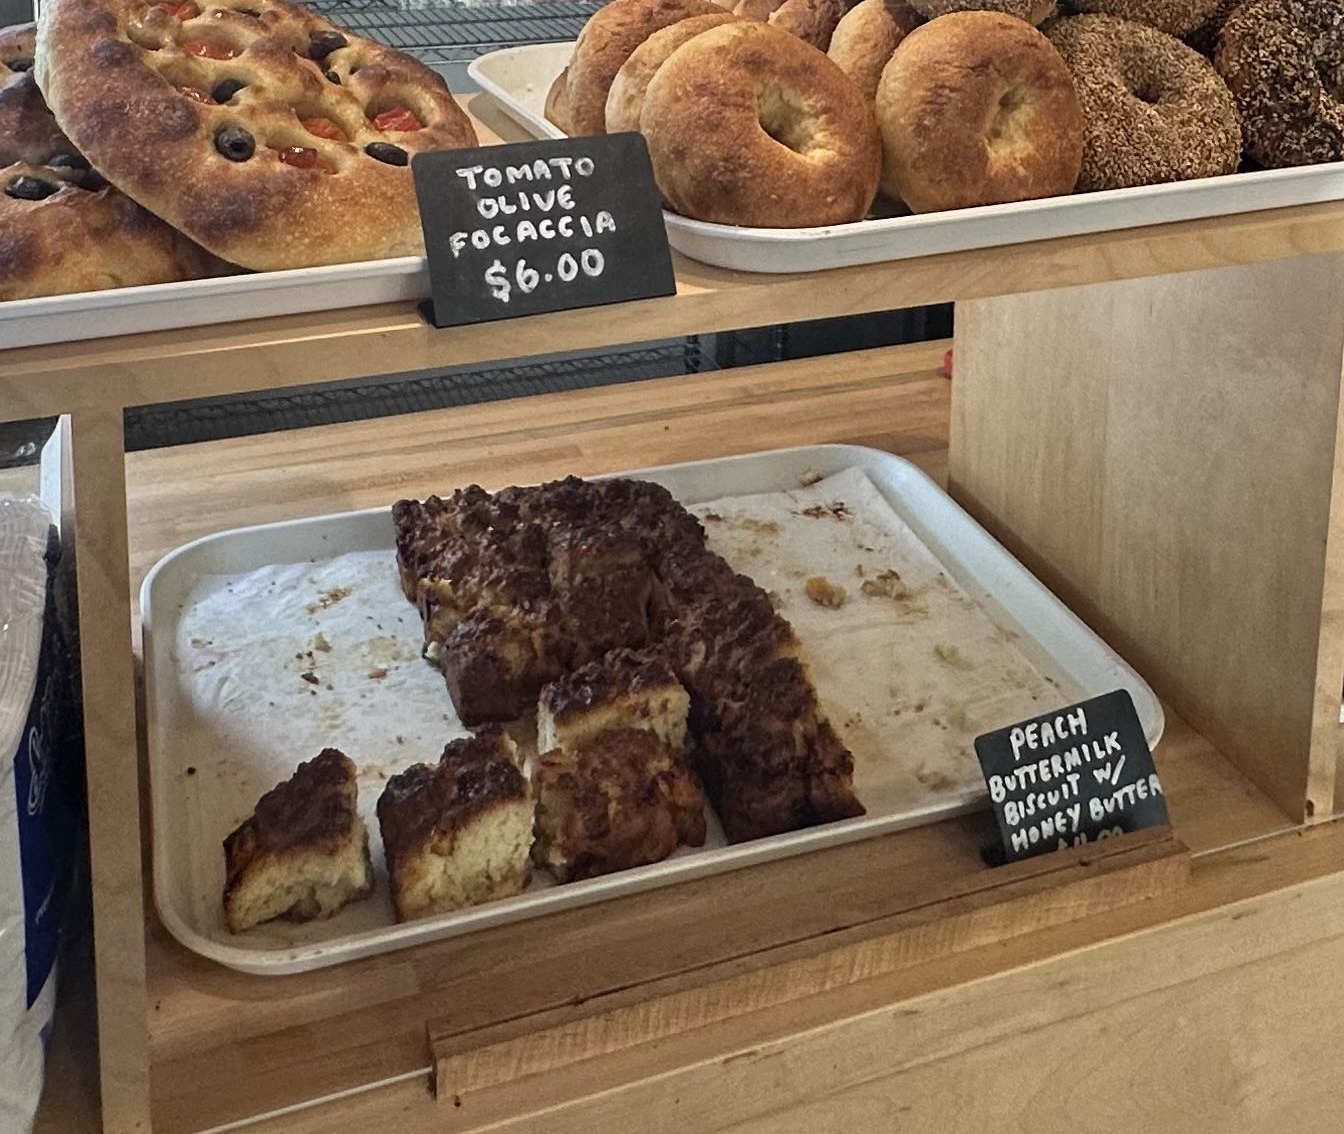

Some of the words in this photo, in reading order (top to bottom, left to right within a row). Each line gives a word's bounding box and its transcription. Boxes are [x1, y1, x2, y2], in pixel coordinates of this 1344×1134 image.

[455, 157, 595, 190] TOMATO
[477, 184, 575, 219] OLIVE
[449, 210, 616, 259] FOCACCIA
[484, 248, 605, 302] $6.00
[1009, 707, 1087, 760] PEACH
[988, 731, 1121, 803] BUTTERMILK
[1004, 773, 1080, 826] BISCUIT
[1011, 802, 1081, 852] HONEY
[1089, 773, 1163, 822] BUTTER
